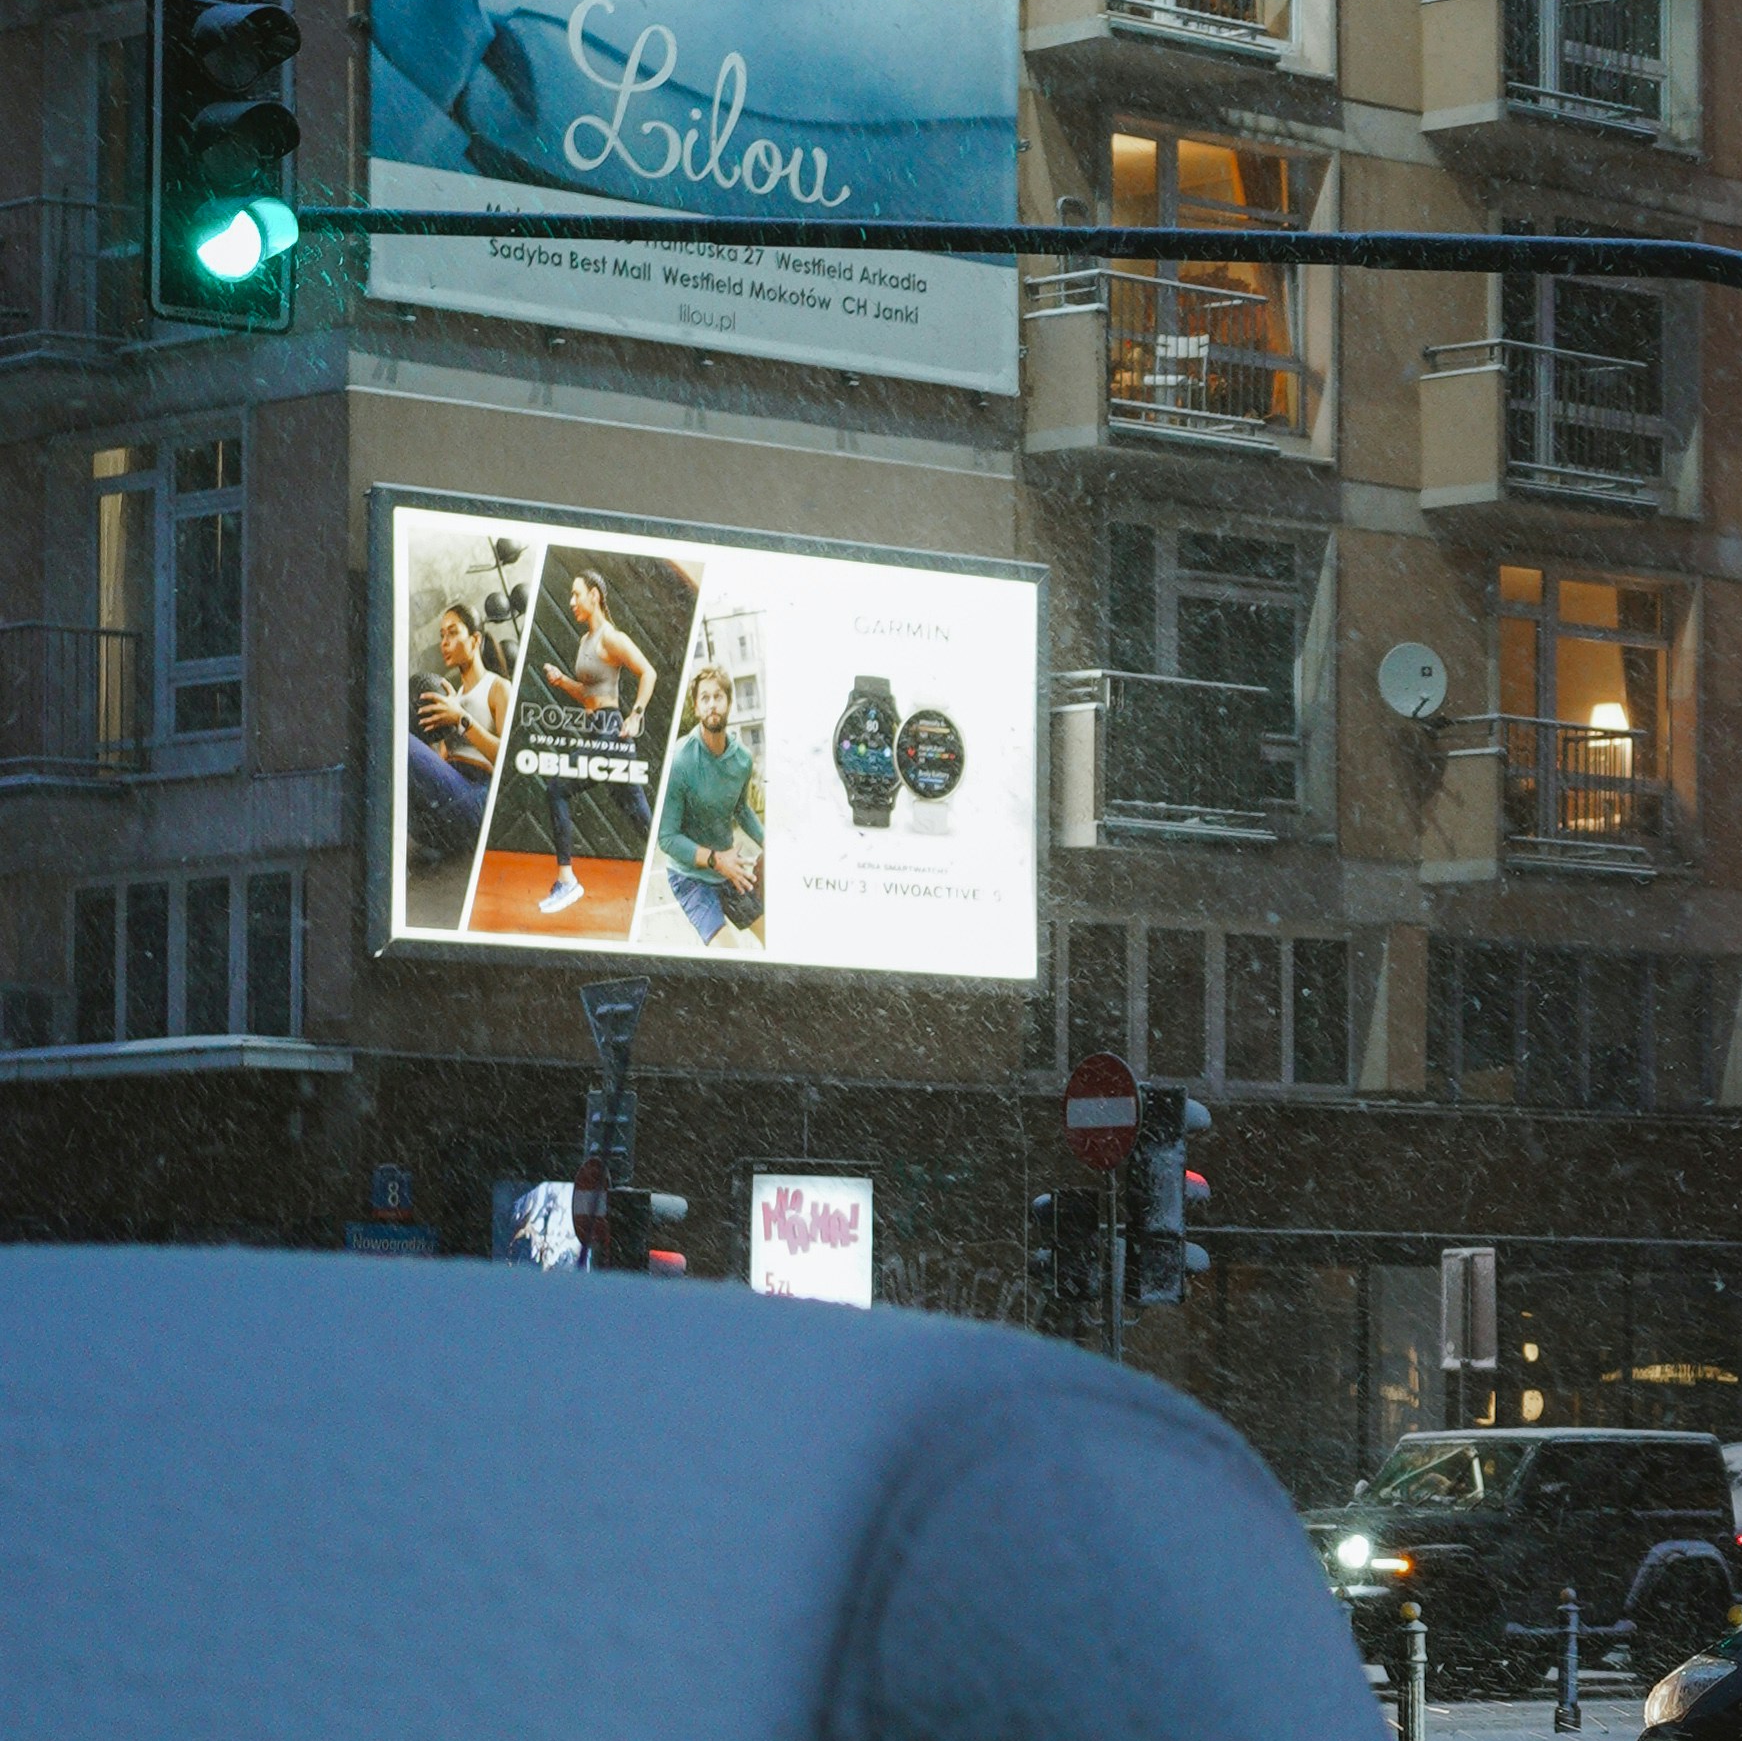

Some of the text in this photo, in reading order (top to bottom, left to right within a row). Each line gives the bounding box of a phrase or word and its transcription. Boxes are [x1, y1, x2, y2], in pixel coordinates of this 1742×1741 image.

[489, 237, 919, 324] Sadyba Best Mall Westfield Mokotów CH Janki
[743, 246, 765, 266] 27
[776, 250, 854, 282] Westfield
[859, 266, 927, 293] Arkadia
[680, 303, 736, 332] lilou.pl
[854, 616, 949, 641] GARMIN
[529, 734, 636, 753] SWOJE PRAWDZIWE
[515, 749, 649, 784] OBLICZE
[859, 880, 867, 893] 3
[388, 1181, 399, 1207] 8
[765, 1271, 775, 1297] 5
